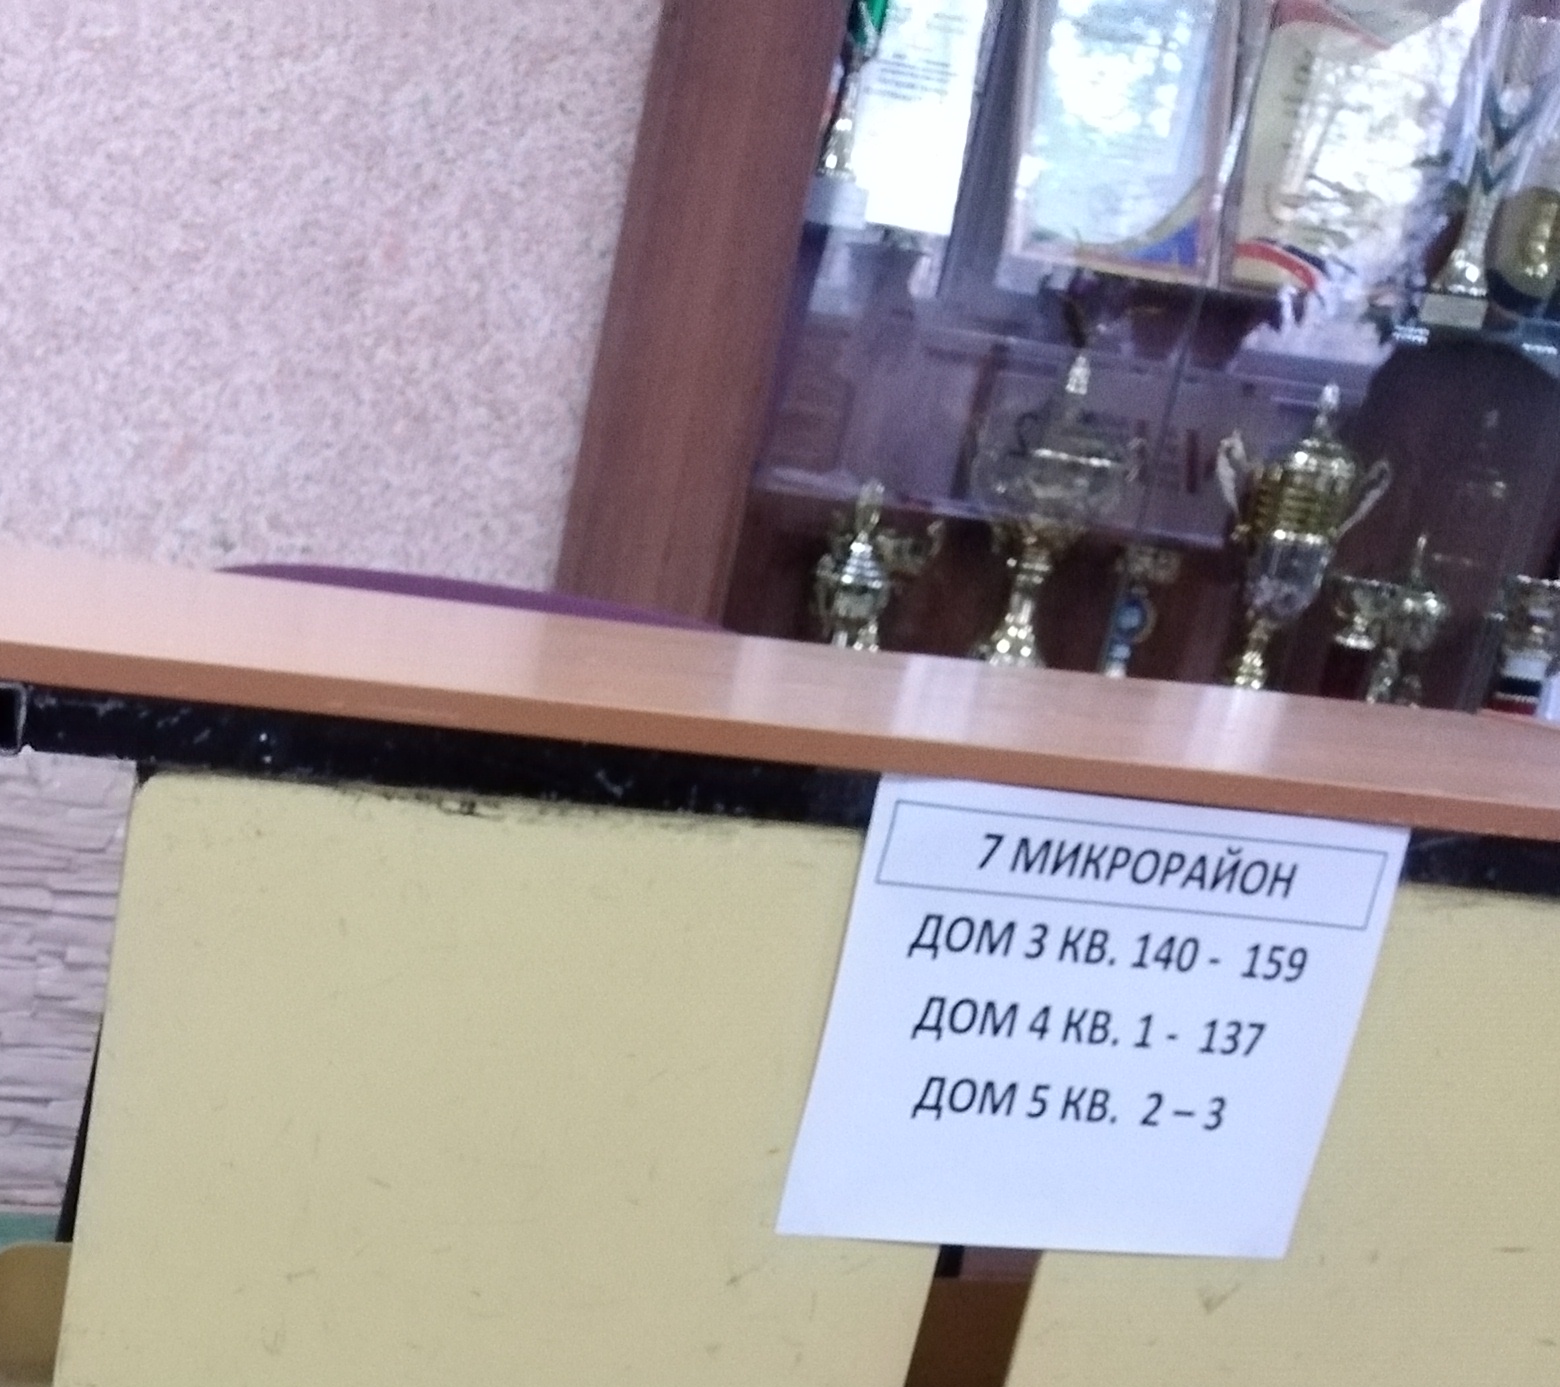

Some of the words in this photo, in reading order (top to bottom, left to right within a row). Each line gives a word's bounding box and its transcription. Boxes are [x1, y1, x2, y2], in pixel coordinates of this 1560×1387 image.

[977, 832, 1006, 871] 7
[1009, 836, 1298, 899] МИКРОРАЙОН
[906, 912, 1018, 961] ДОМ
[1023, 922, 1050, 960] 3
[1057, 925, 1116, 967] КВ.
[1130, 932, 1200, 974] 140
[1240, 943, 1309, 984] 159
[910, 995, 1020, 1042] ДОМ
[1027, 1004, 1052, 1041] 4
[1061, 1006, 1119, 1047] КВ.
[1132, 1013, 1154, 1050] 1
[1198, 1018, 1267, 1057] 137
[910, 1075, 1019, 1121] ДОМ
[1025, 1083, 1052, 1120] 5
[1059, 1085, 1117, 1125] КВ.
[1139, 1091, 1165, 1128] 2
[1202, 1095, 1227, 1132] 3
